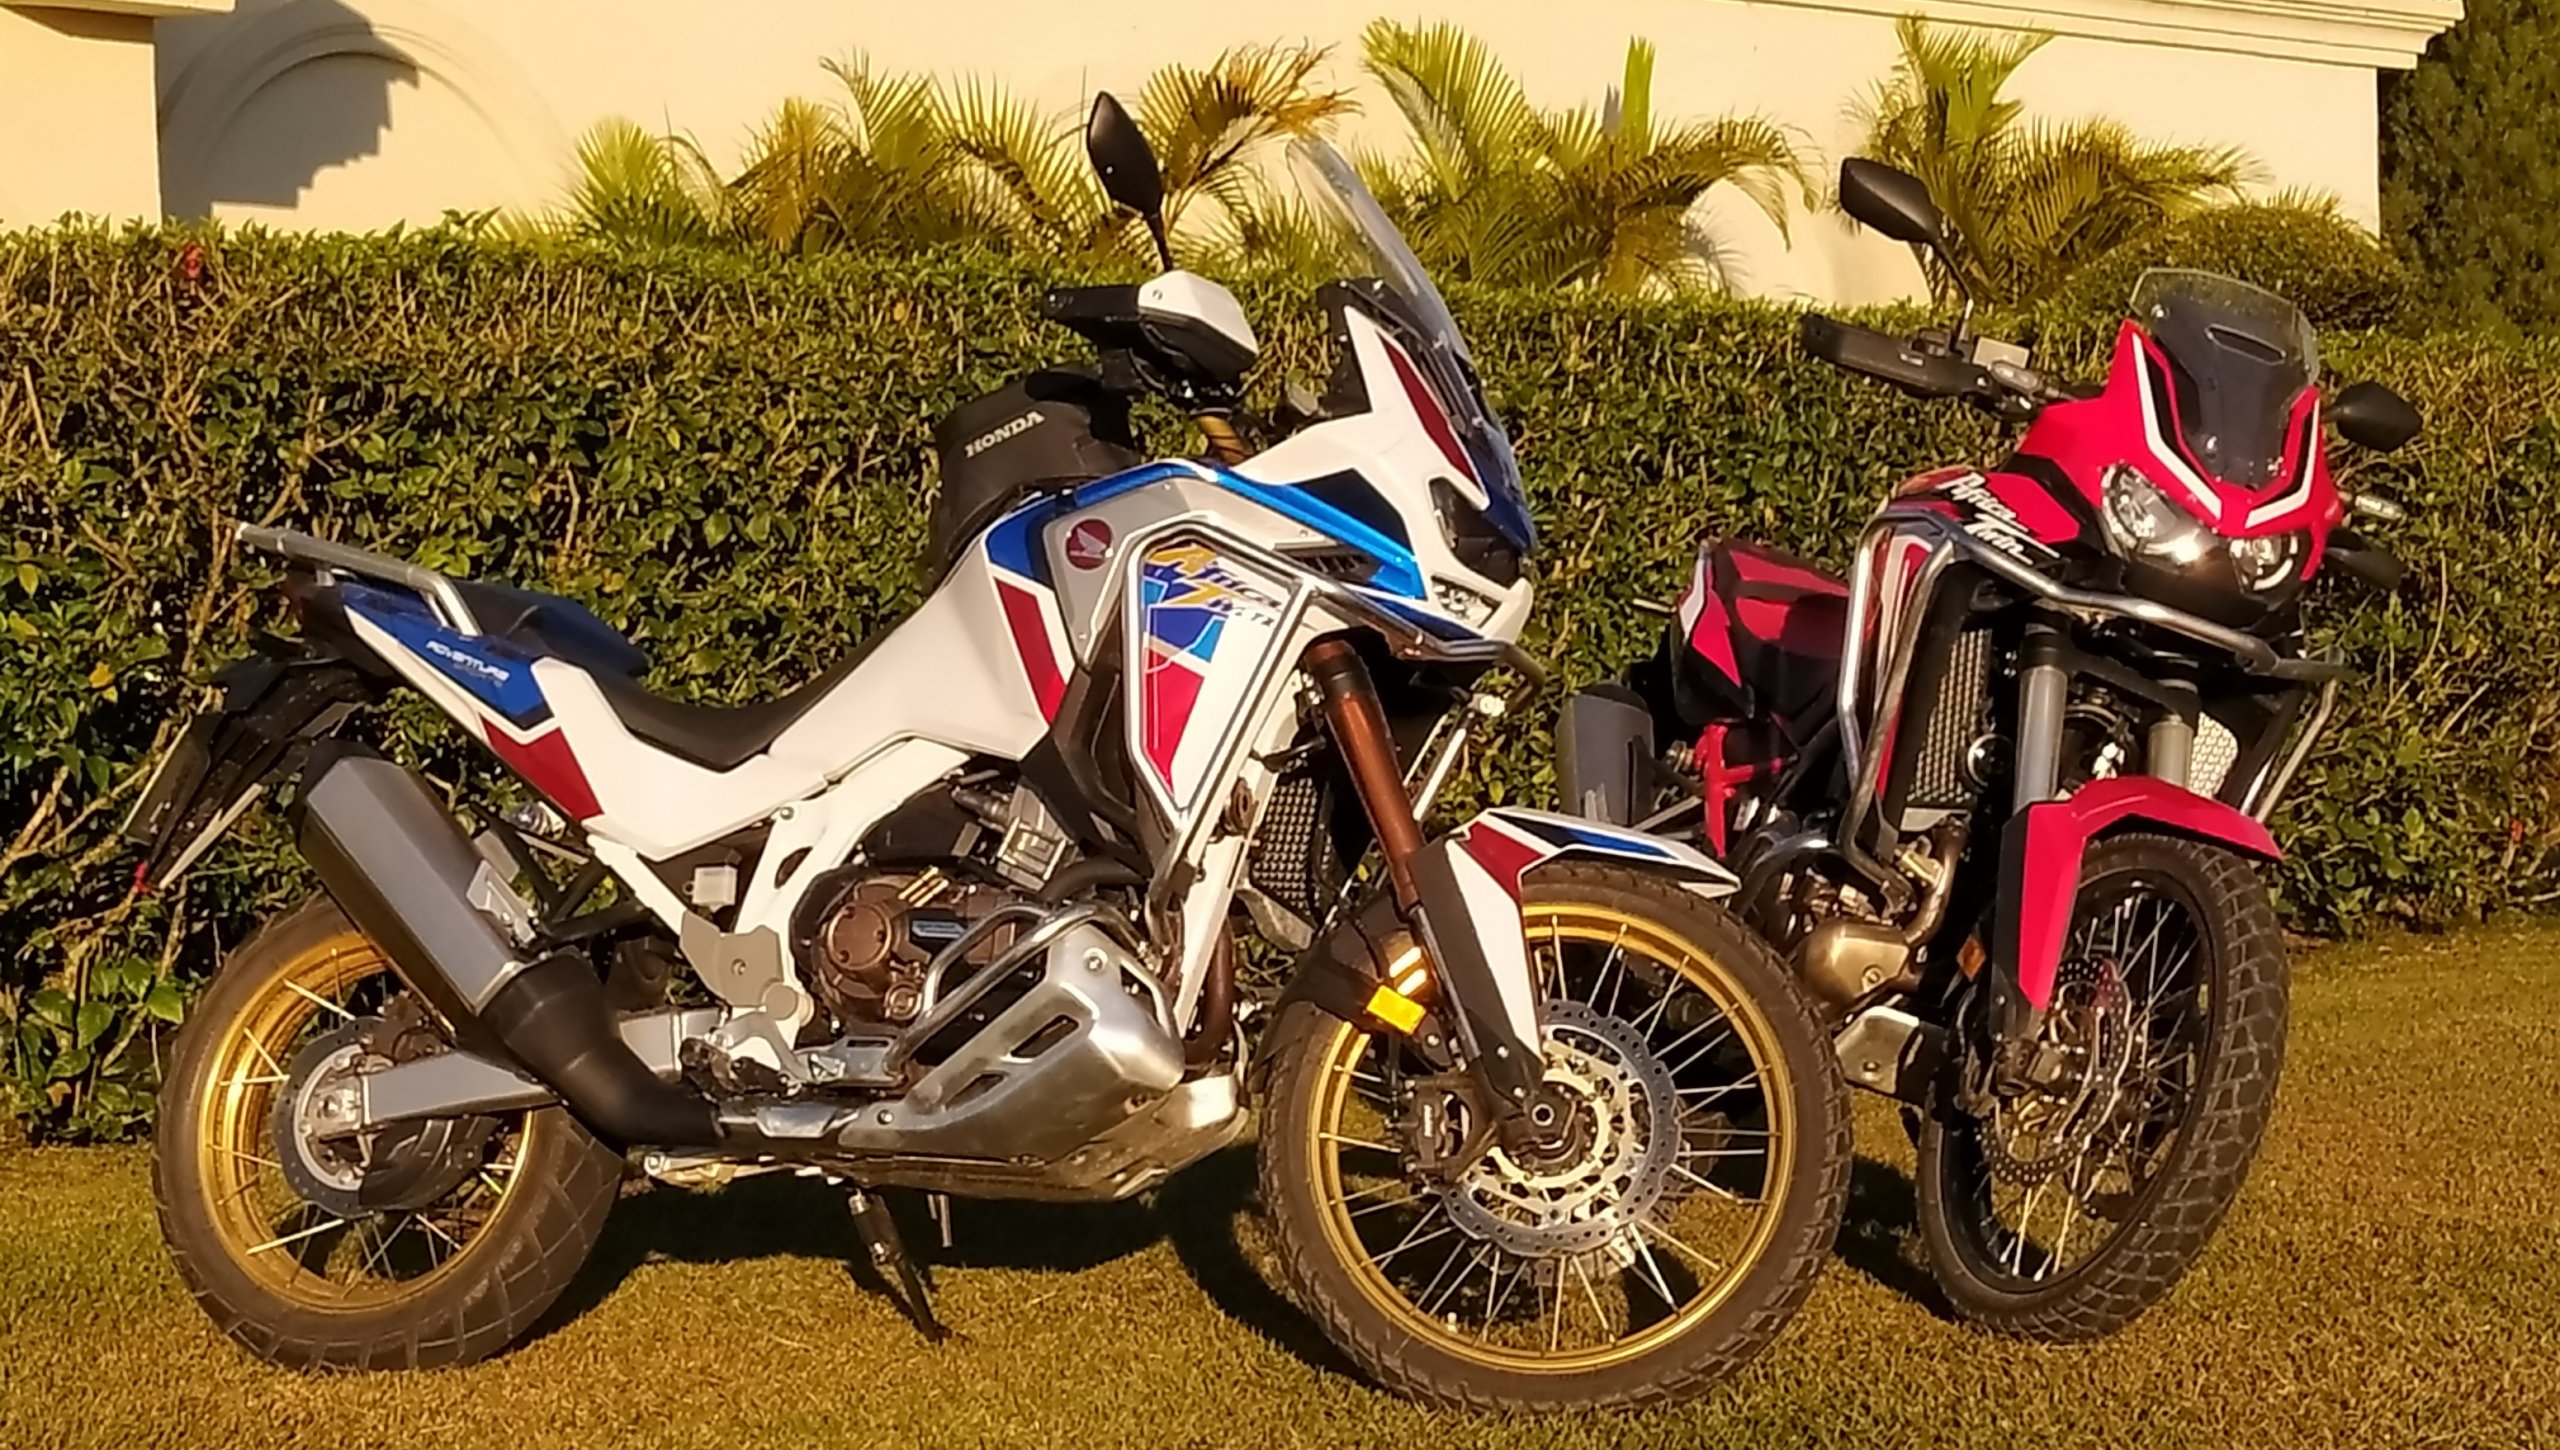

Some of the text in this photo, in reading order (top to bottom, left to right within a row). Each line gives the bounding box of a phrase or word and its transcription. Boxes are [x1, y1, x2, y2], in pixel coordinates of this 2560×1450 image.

[964, 411, 1046, 458] HONDA
[1934, 472, 2029, 533] Africa
[1963, 513, 2061, 566] Twin
